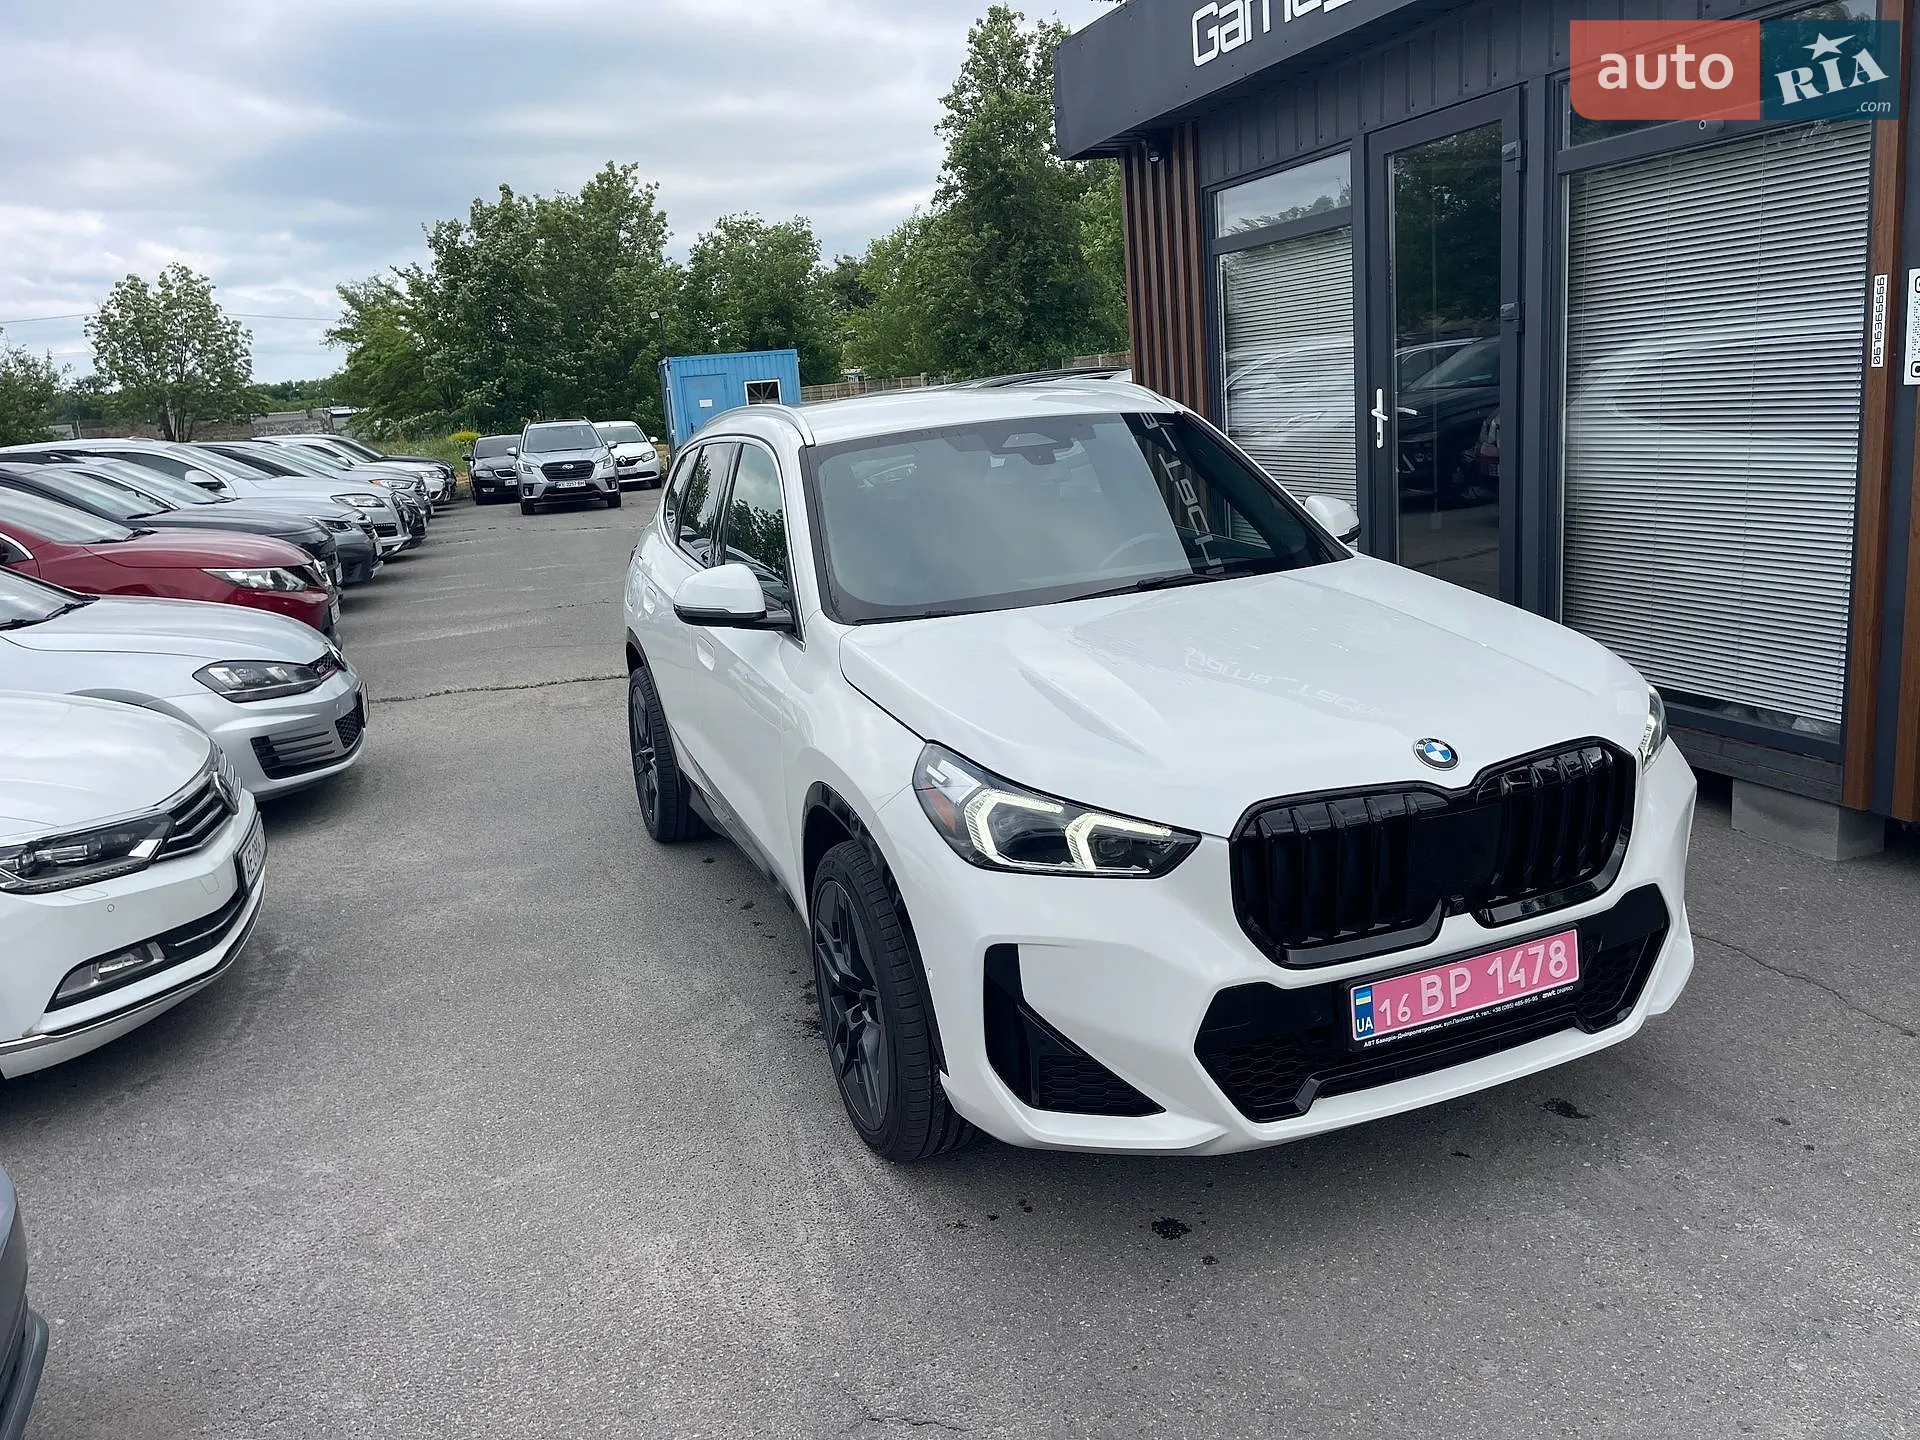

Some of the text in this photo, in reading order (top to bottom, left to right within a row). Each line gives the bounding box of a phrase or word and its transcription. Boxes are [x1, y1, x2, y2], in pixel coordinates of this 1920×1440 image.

[1872, 276, 1885, 365] 0676366666
[1356, 1016, 1374, 1032] UA
[1378, 939, 1568, 1027] 16 BP 1478
